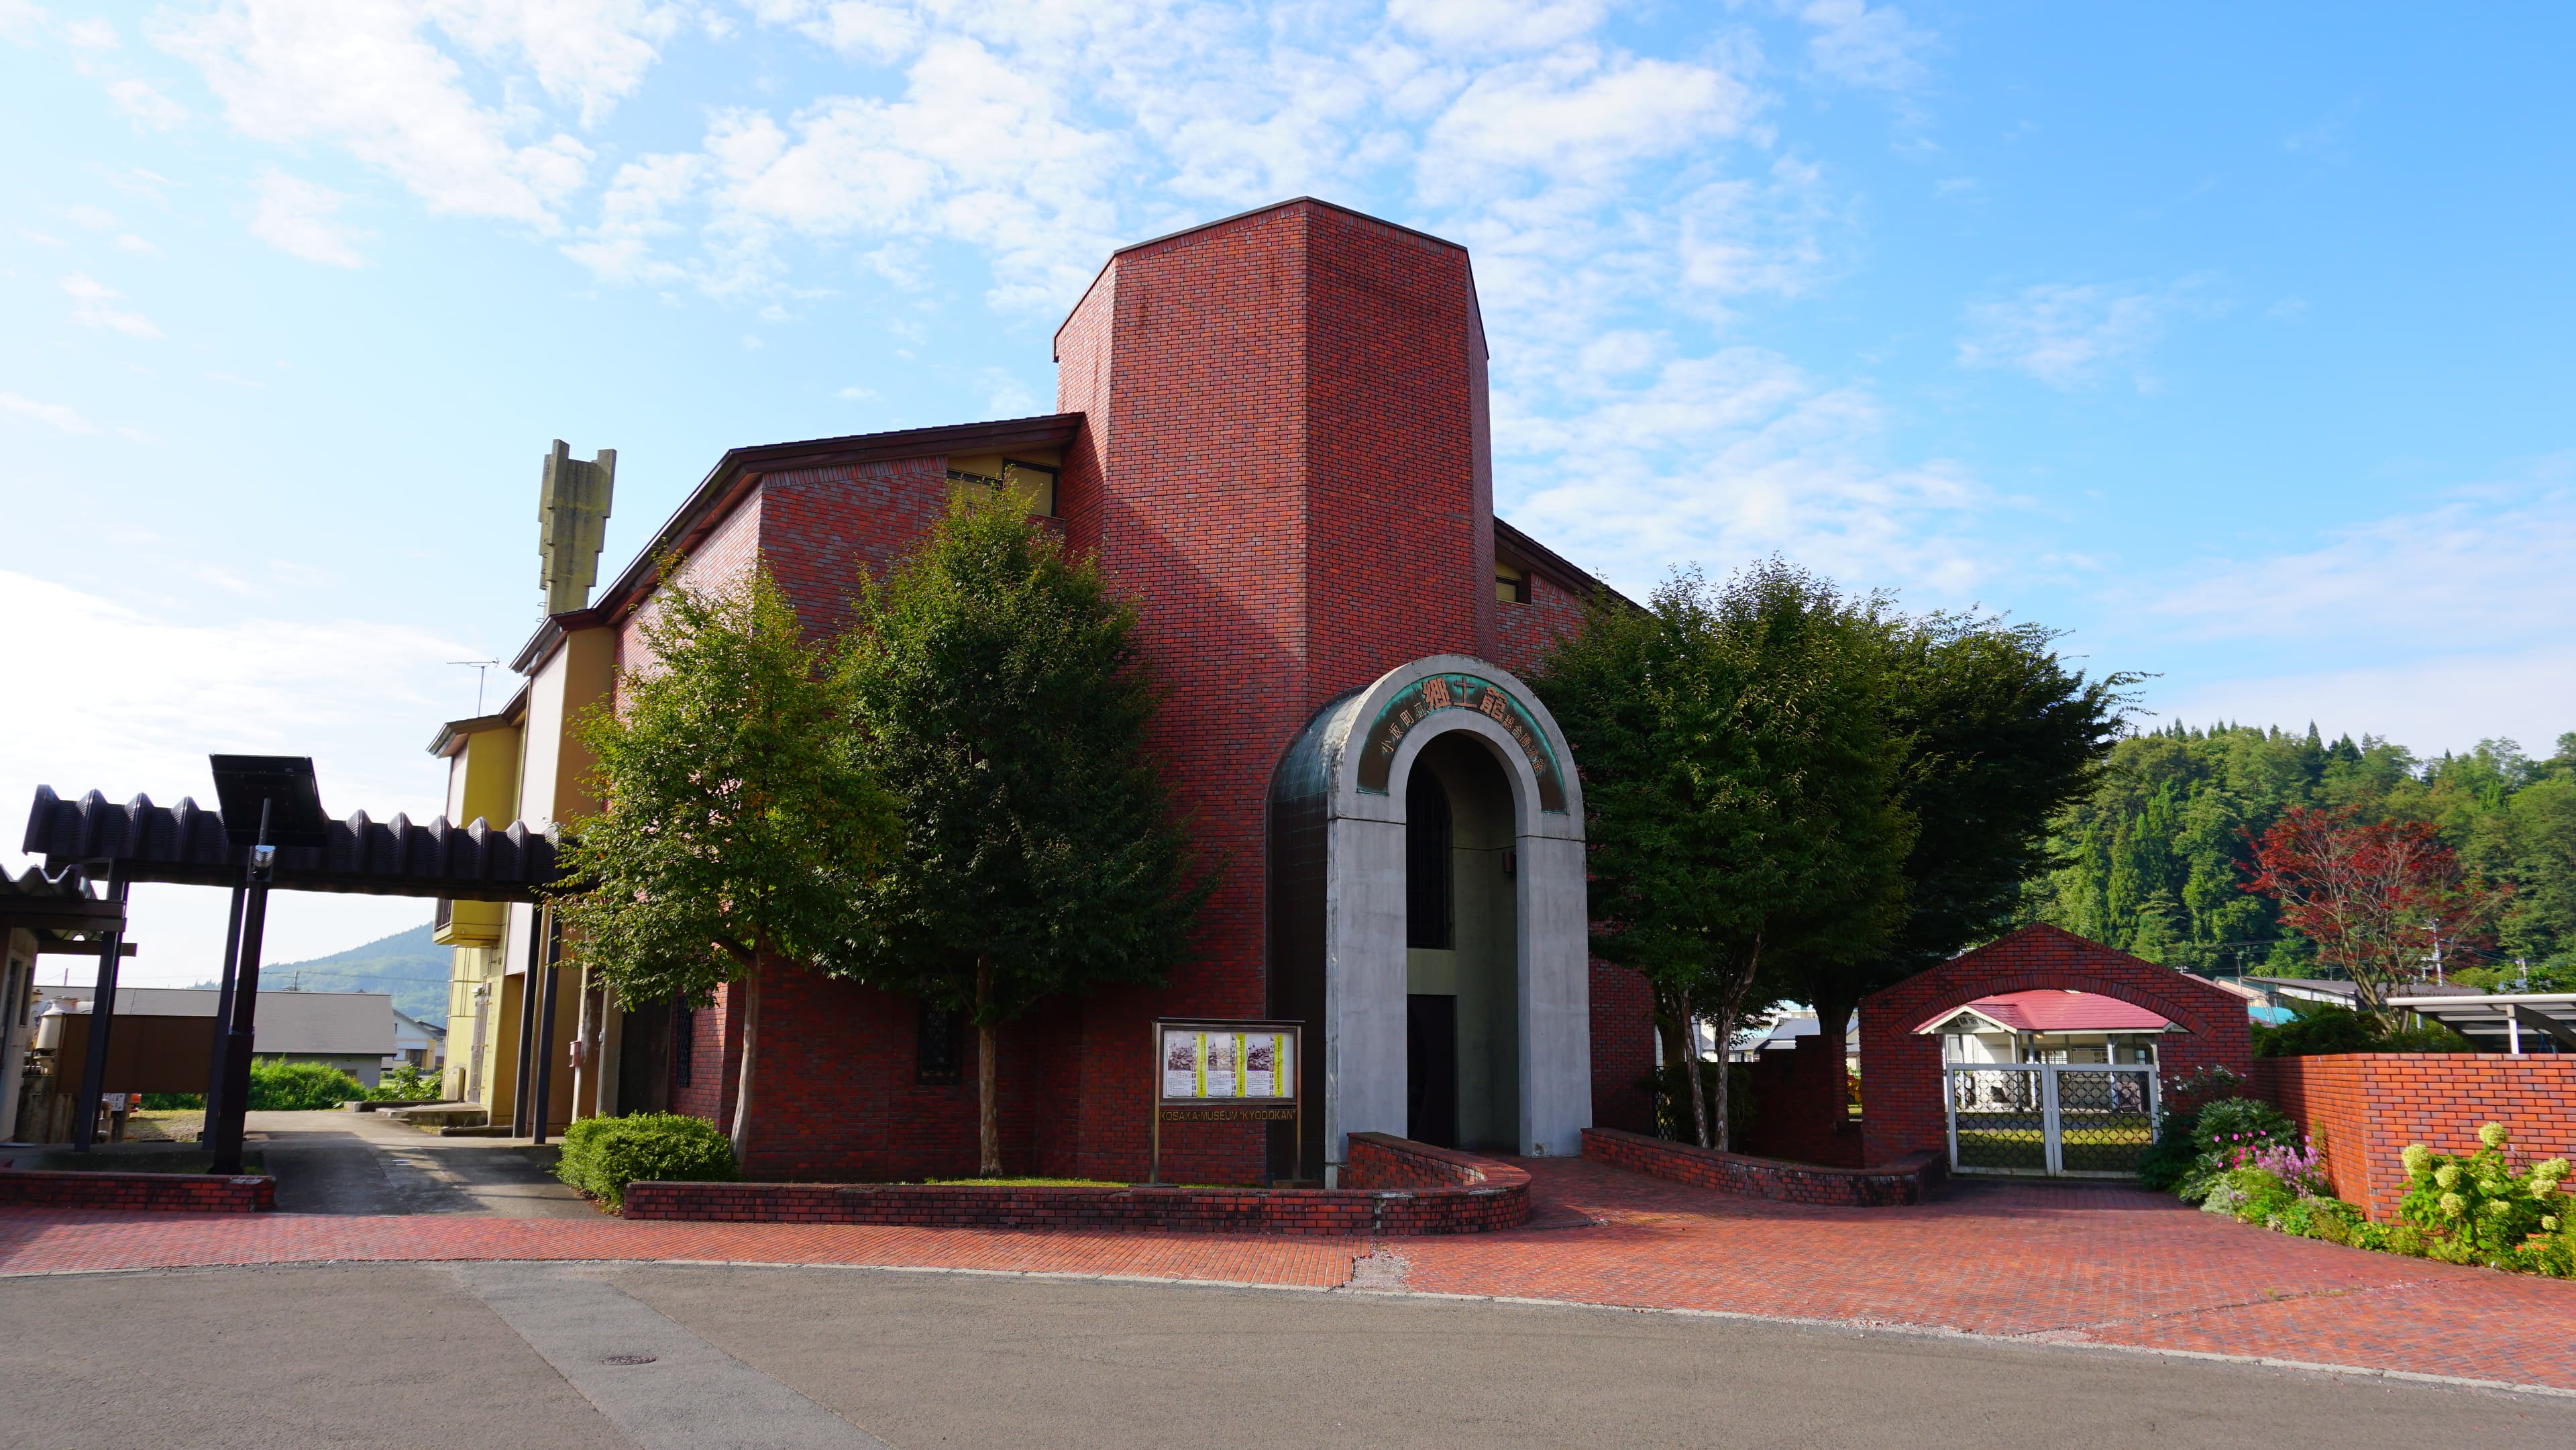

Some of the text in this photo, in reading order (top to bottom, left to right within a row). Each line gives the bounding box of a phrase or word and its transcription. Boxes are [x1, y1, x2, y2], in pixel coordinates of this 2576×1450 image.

[1381, 701, 1427, 753] 小坂町立
[1421, 676, 1507, 723] 郷土館
